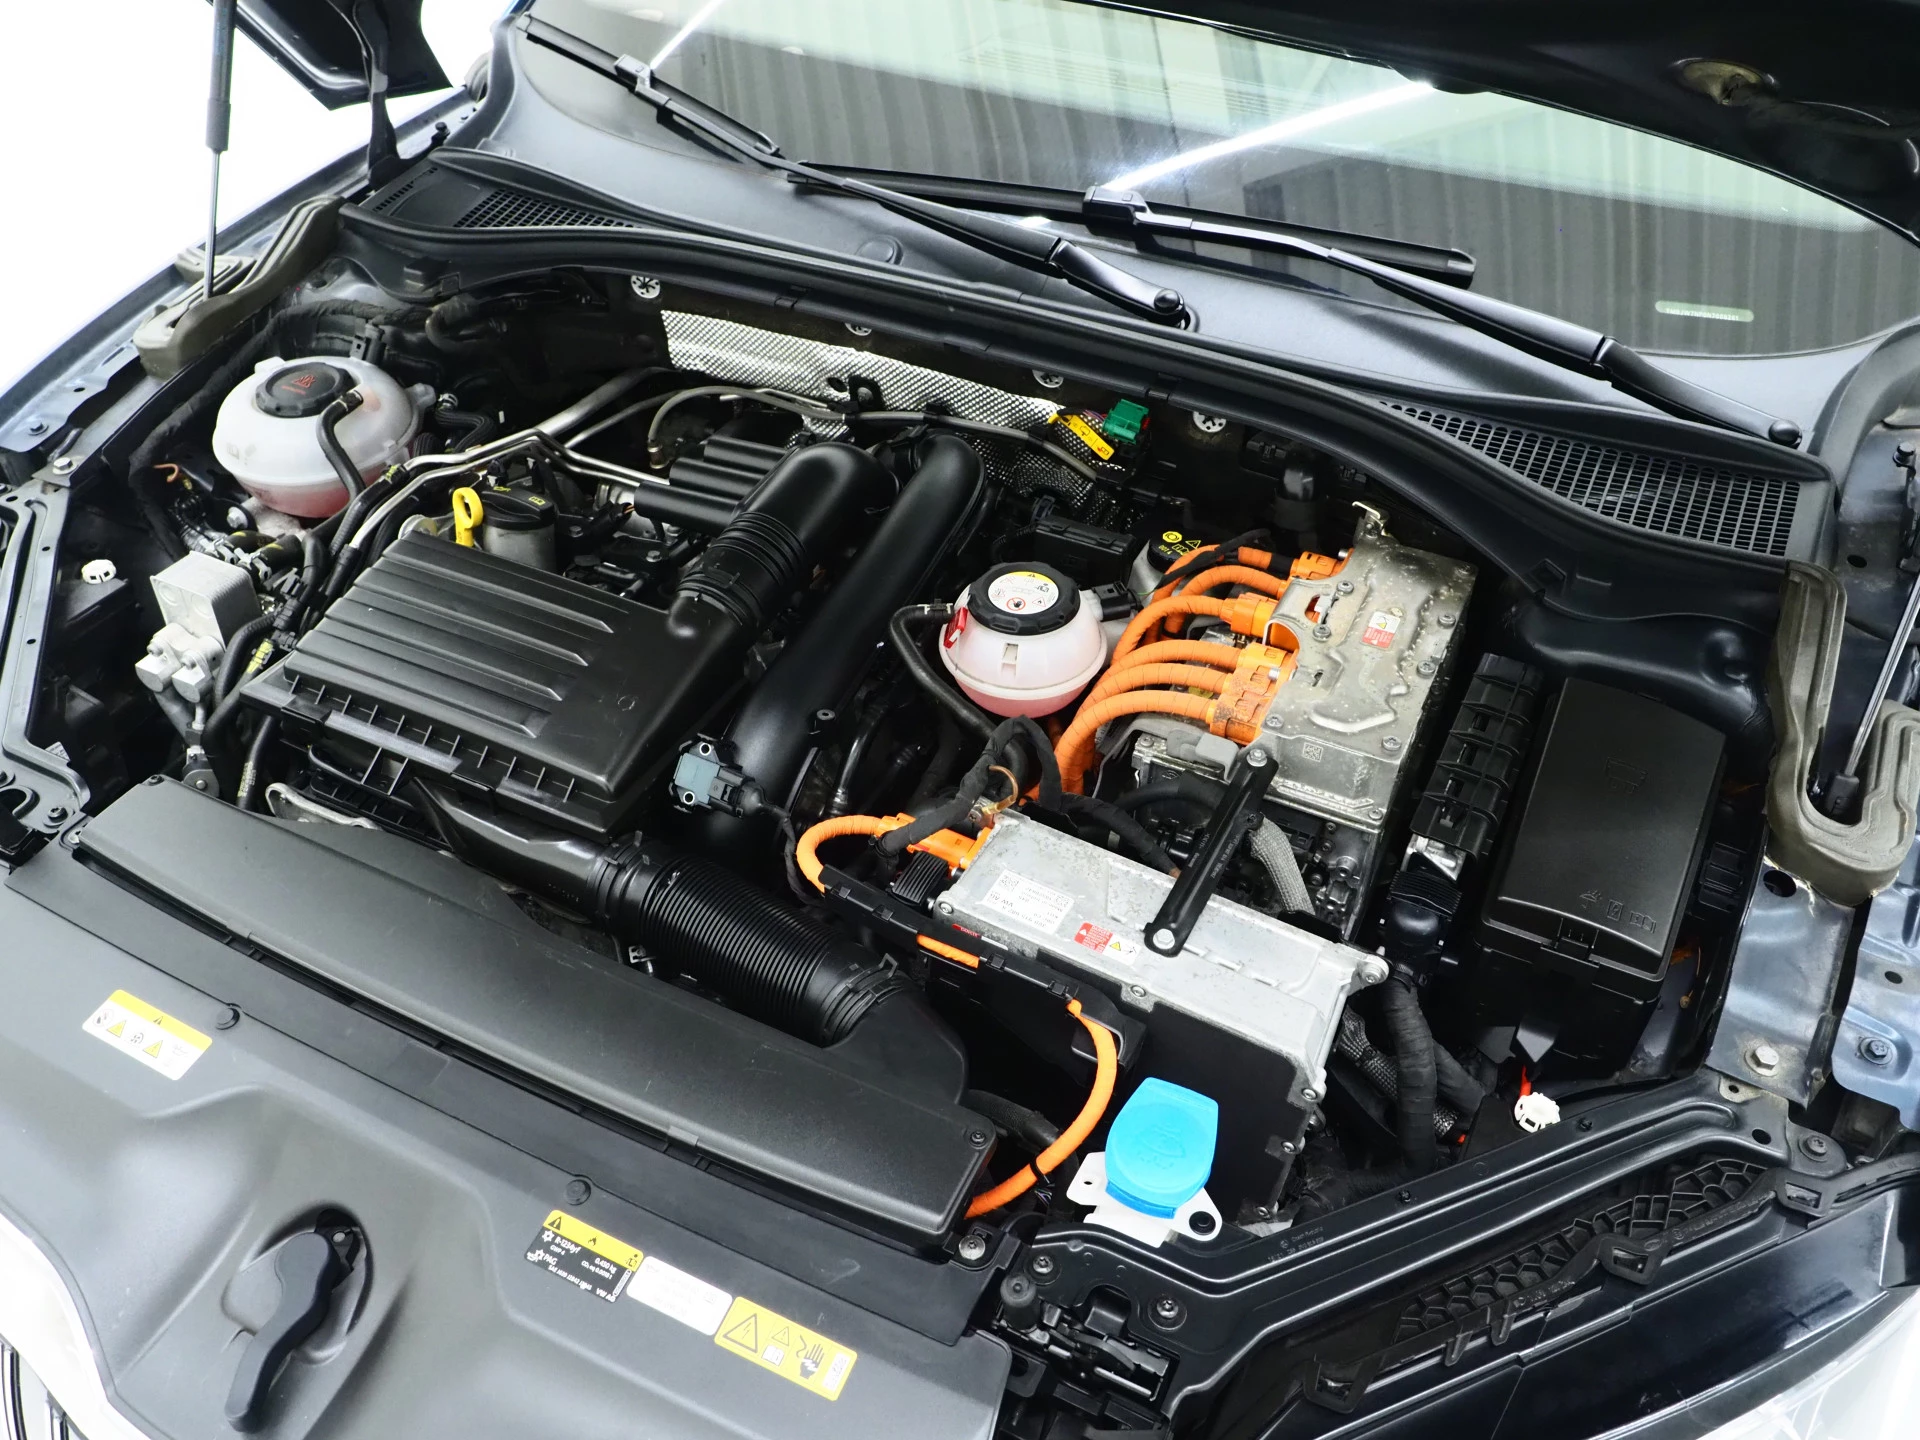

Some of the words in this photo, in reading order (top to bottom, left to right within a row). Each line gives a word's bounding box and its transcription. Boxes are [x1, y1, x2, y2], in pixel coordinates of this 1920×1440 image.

[554, 1236, 582, 1253] R-1234yf
[543, 1252, 558, 1265] PAG
[609, 1264, 618, 1275] kg
[596, 1288, 607, 1298] VW
